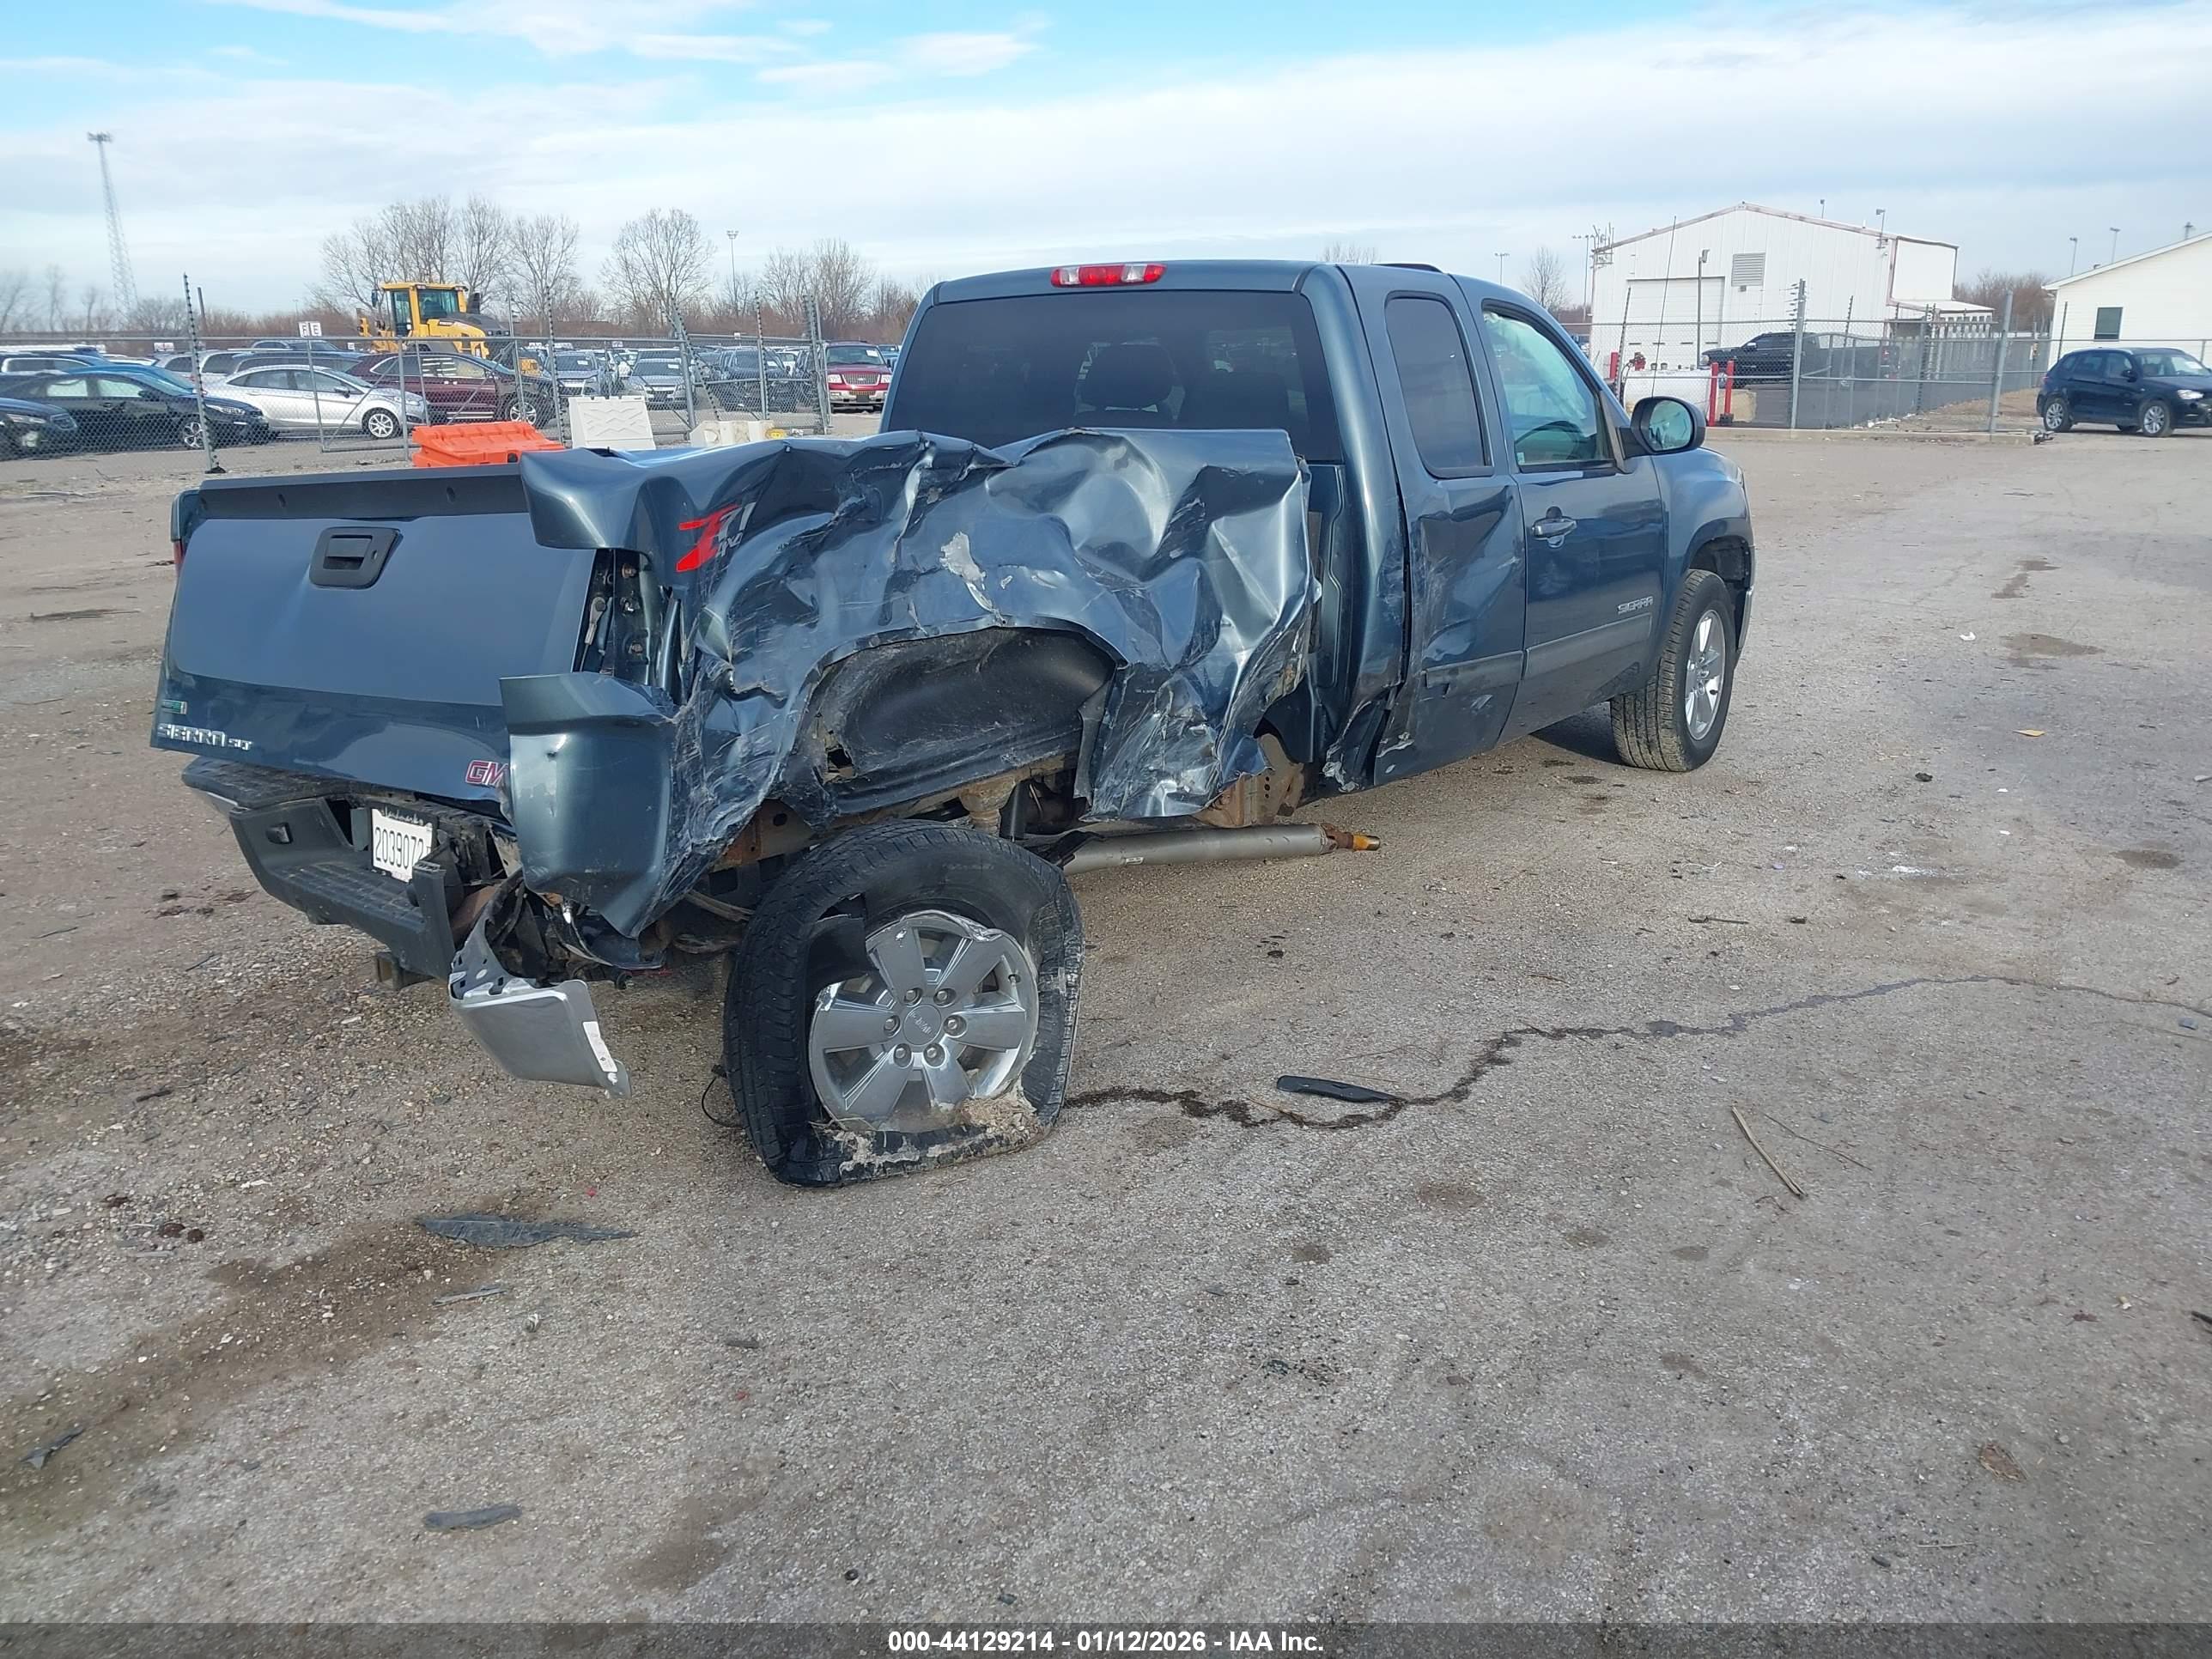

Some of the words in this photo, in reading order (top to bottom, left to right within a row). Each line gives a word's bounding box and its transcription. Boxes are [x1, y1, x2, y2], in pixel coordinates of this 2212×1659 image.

[1617, 596, 1654, 615] SIERRA
[157, 723, 226, 747] SIERRA
[465, 759, 508, 787] GM
